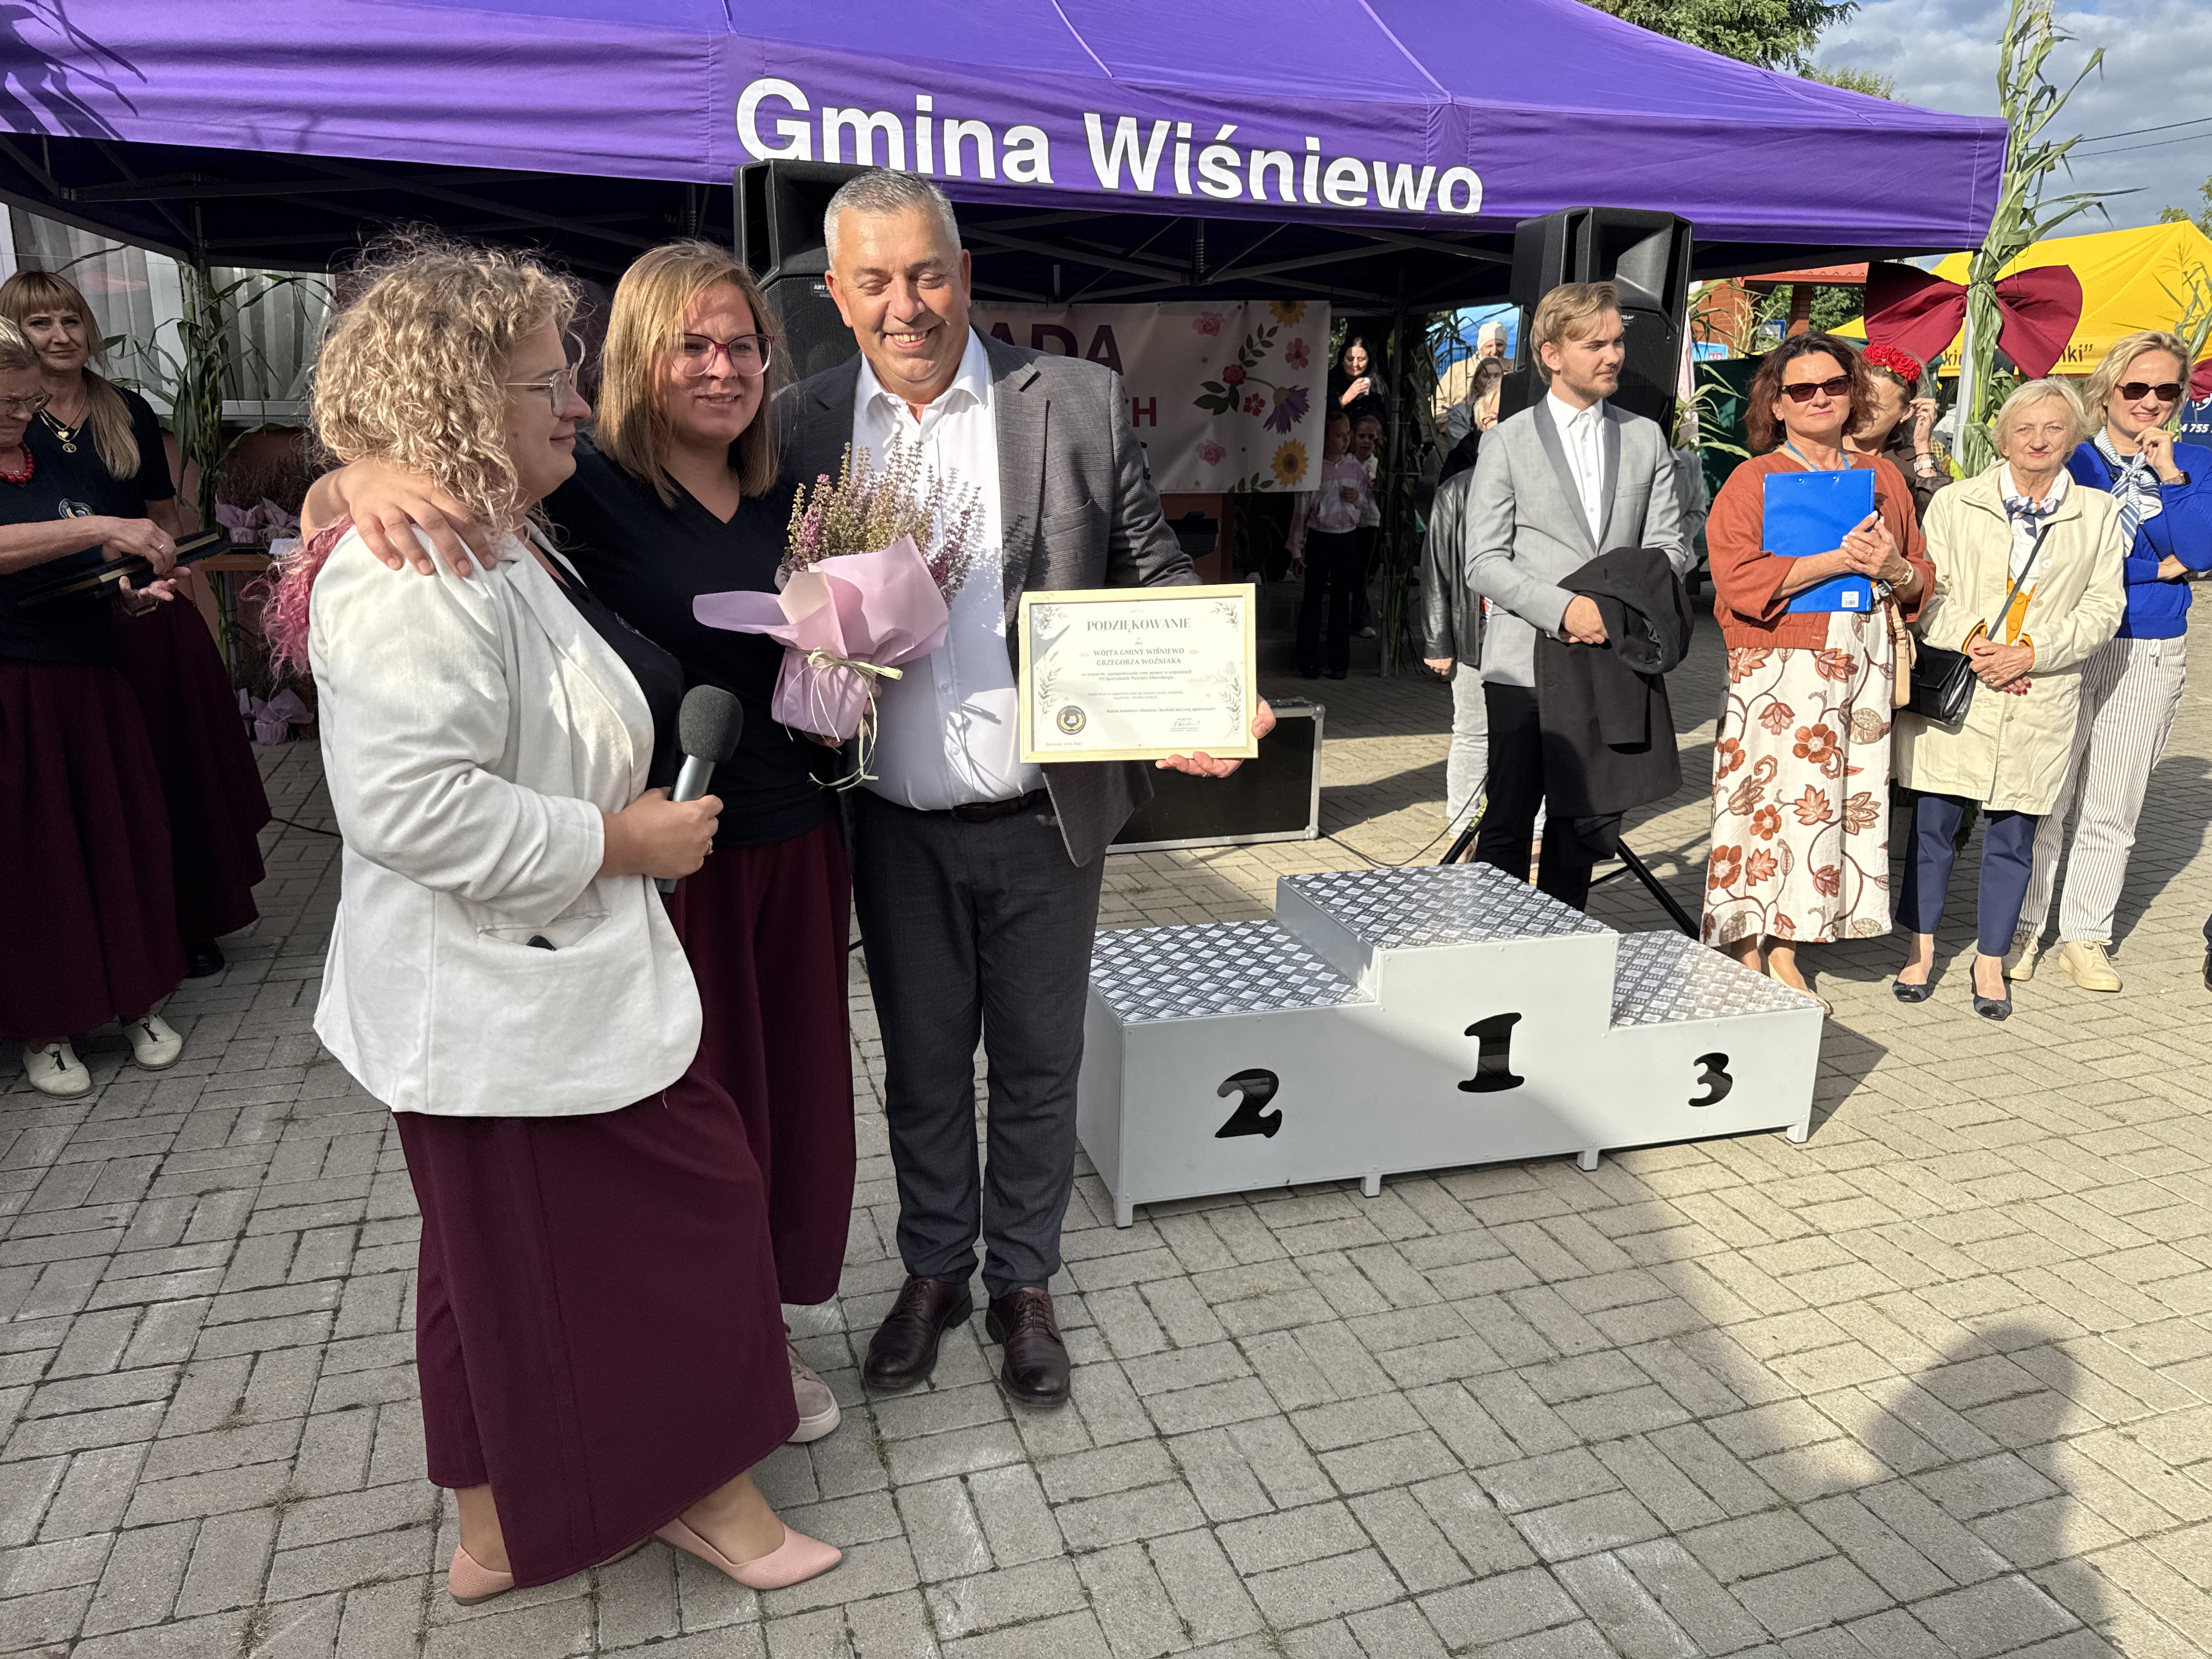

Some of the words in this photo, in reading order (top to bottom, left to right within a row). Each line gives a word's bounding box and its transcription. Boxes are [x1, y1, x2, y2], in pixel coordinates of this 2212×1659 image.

[736, 78, 1054, 184] Gmina
[1084, 112, 1483, 213] Wiśniewo
[1125, 397, 1156, 427] H
[2189, 424, 2209, 433] 755
[1087, 618, 1191, 633] PODZIĘKOWANIE
[1093, 648, 1118, 657] WÓJTA
[1146, 647, 1184, 655] WIŚNIEWO
[1457, 1012, 1525, 1093] 1
[1688, 1052, 1733, 1107] 3
[1214, 1068, 1283, 1139] 2
